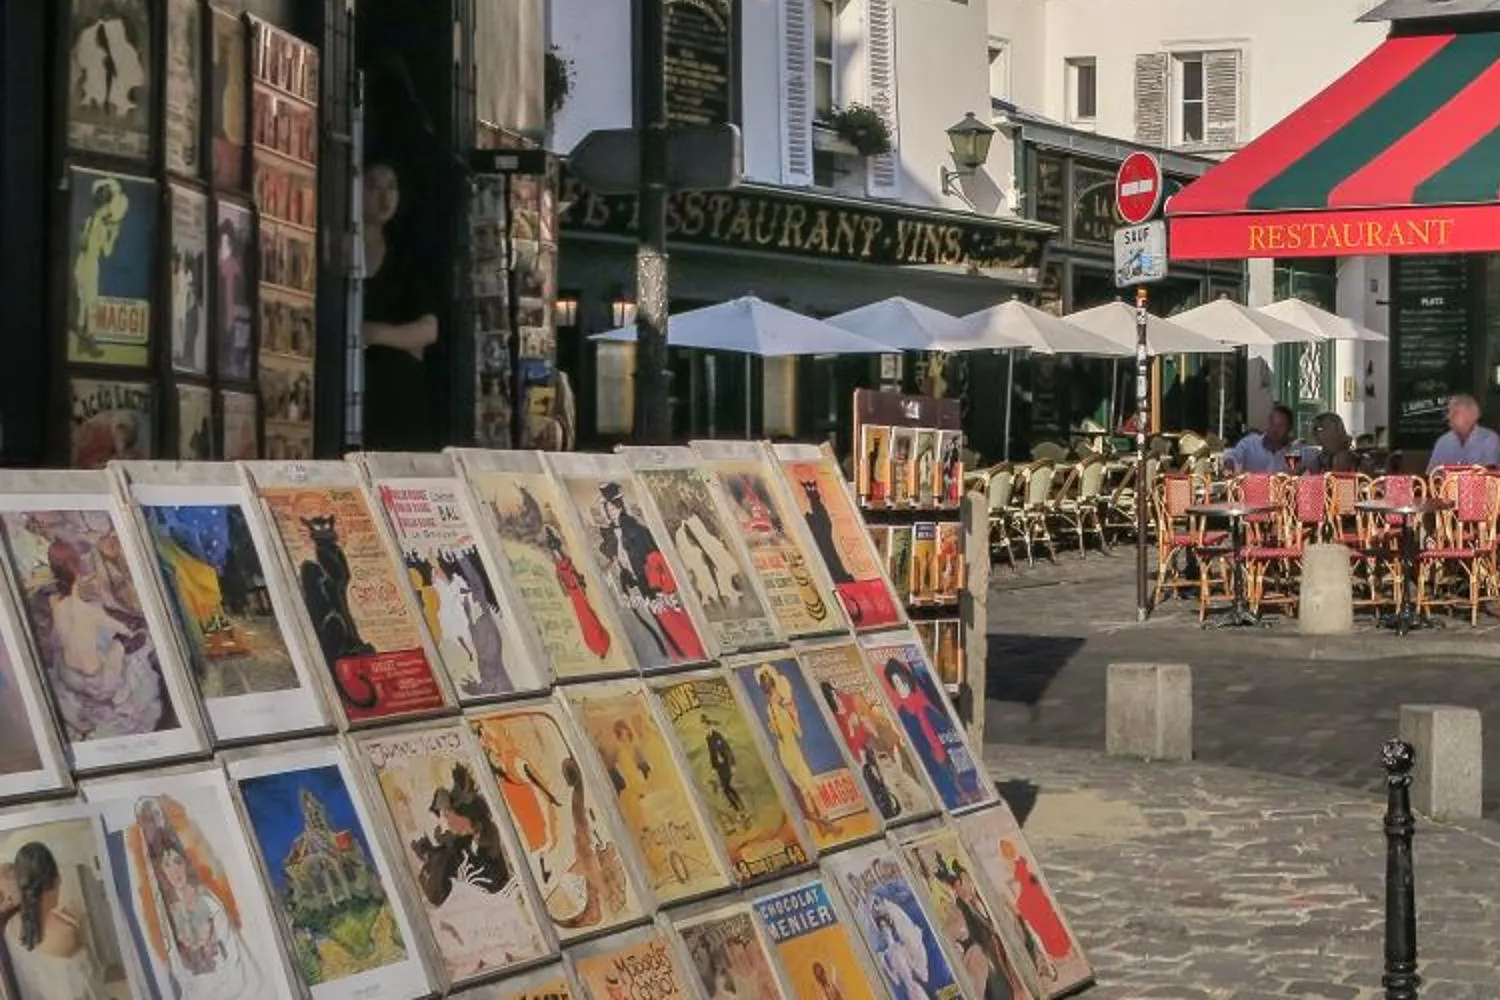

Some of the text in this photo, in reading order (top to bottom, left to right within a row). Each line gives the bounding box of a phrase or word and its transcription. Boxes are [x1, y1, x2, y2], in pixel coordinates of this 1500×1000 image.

[628, 188, 882, 257] STAURANT
[896, 219, 965, 265] VINS
[1124, 227, 1150, 245] SAUF
[1248, 218, 1454, 252] RESTAURANT
[769, 907, 834, 942] MENIER
